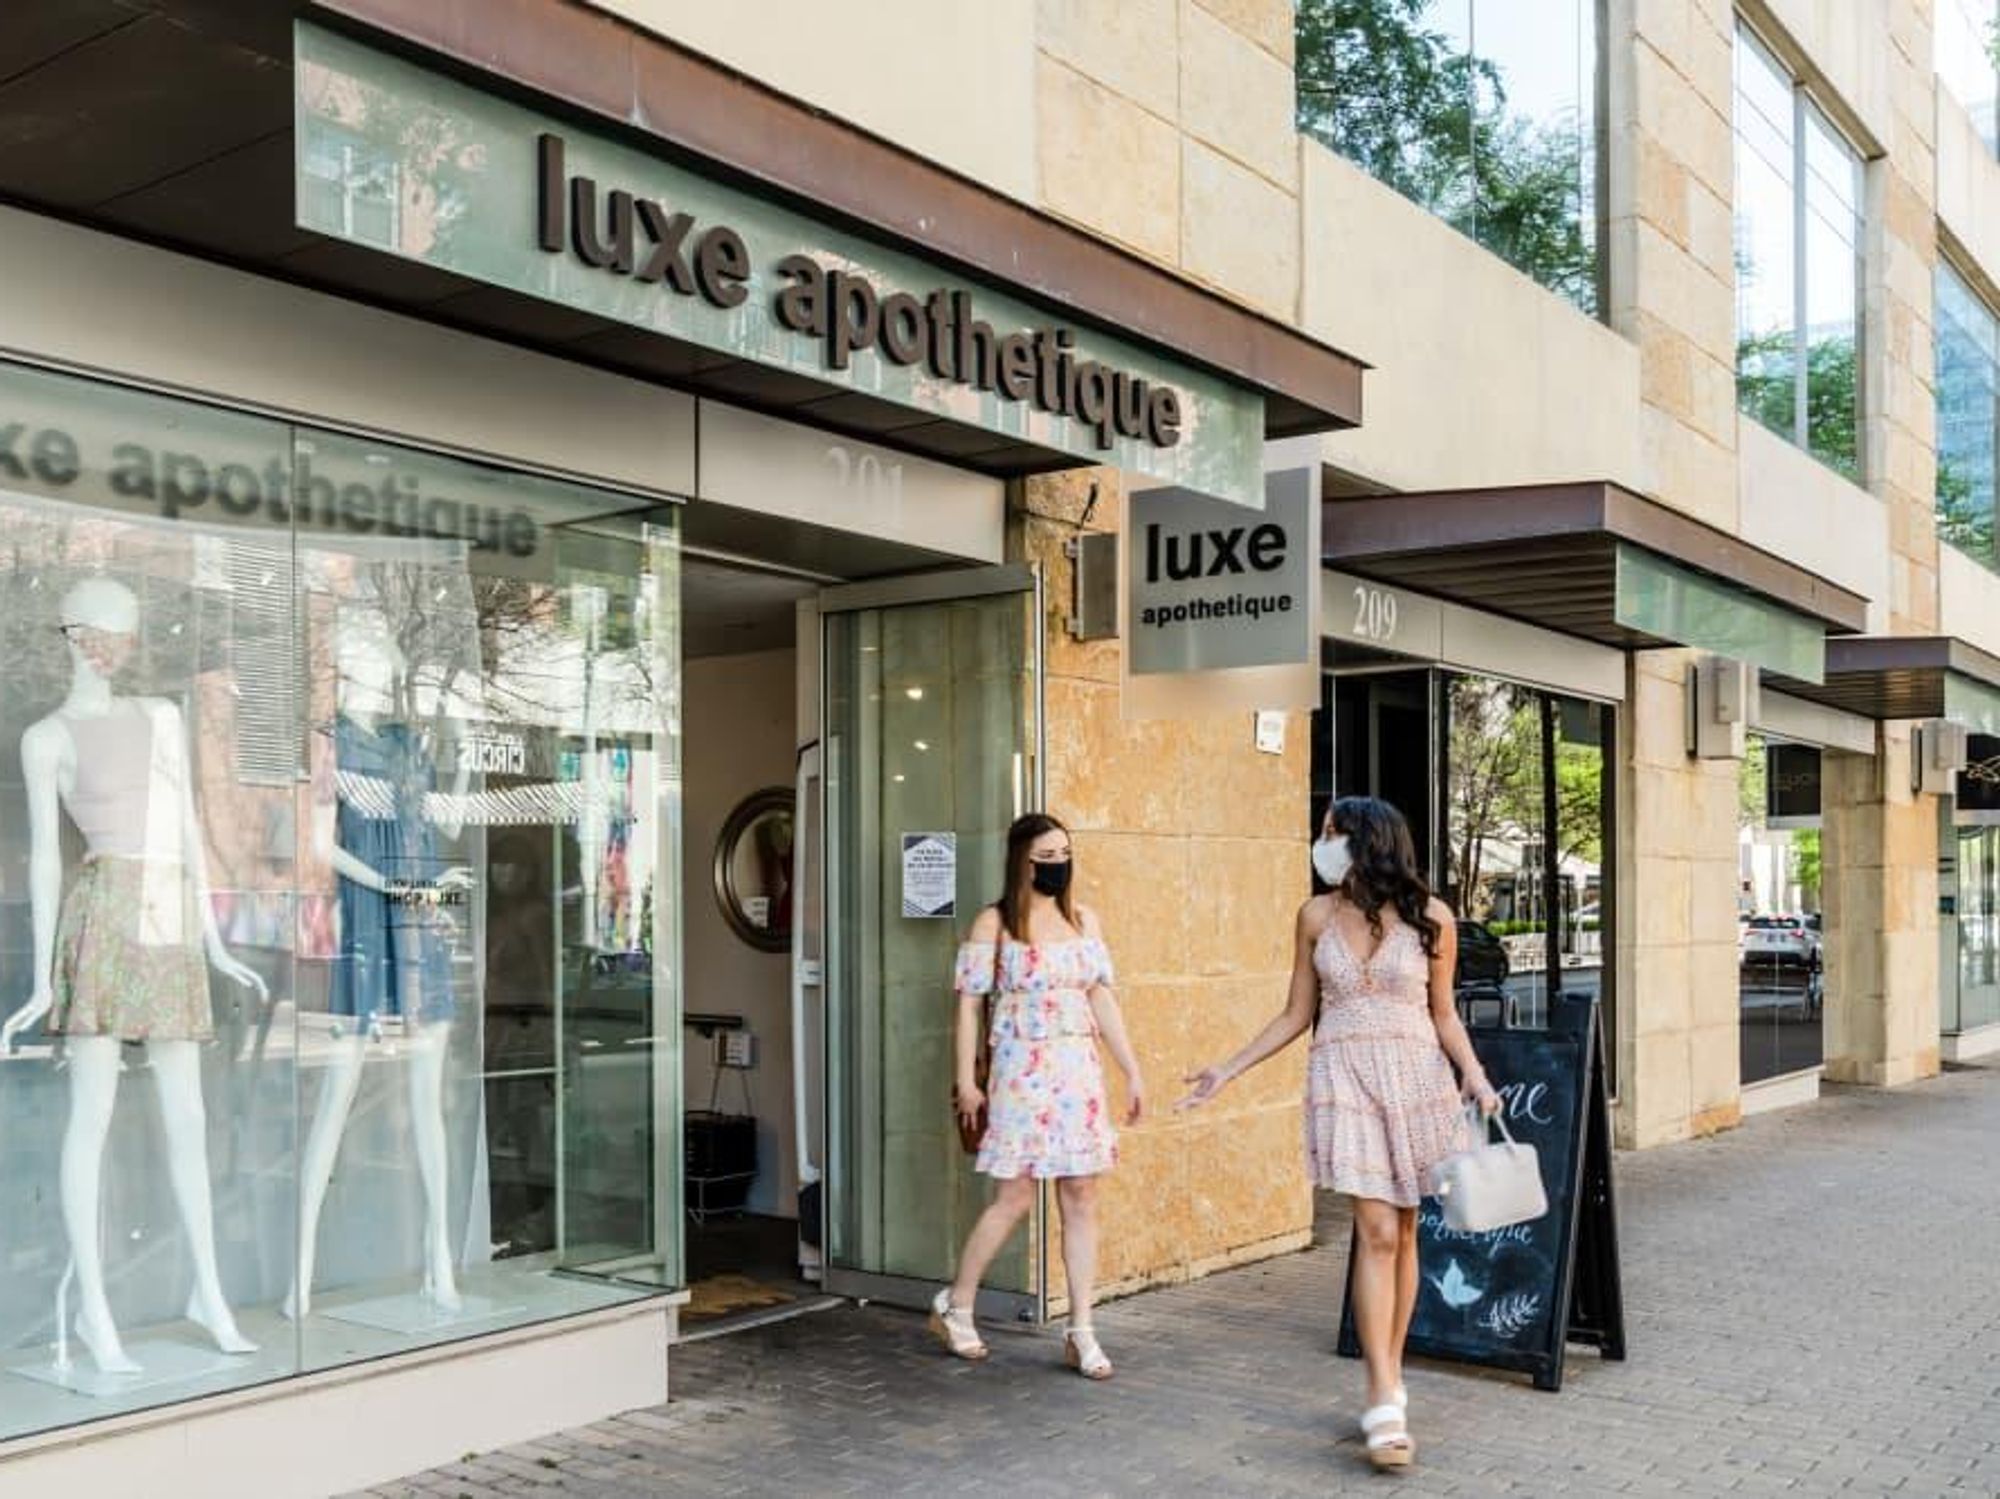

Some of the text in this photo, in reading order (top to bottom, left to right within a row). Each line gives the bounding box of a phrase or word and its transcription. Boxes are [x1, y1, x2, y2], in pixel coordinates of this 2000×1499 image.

[537, 132, 1182, 450] luxe apothetique
[109, 440, 538, 558] apothetique
[1145, 521, 1288, 583] luxe
[1141, 593, 1293, 629] apothetique
[1352, 586, 1397, 641] 209
